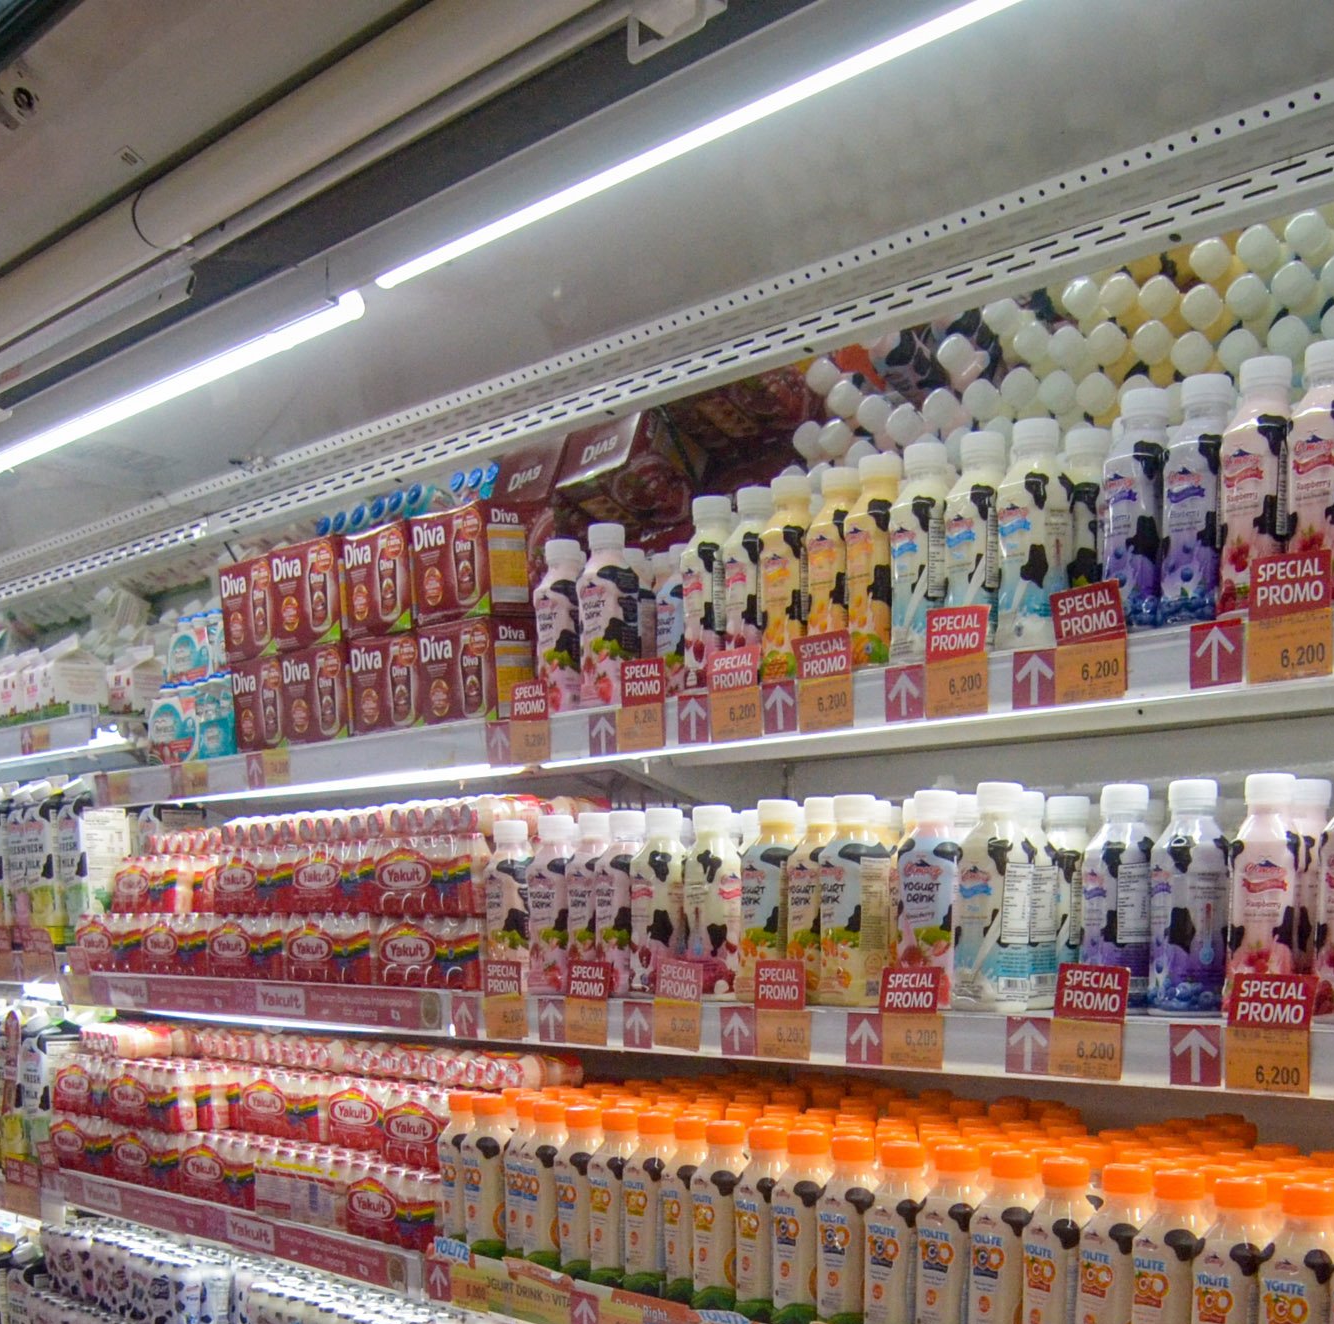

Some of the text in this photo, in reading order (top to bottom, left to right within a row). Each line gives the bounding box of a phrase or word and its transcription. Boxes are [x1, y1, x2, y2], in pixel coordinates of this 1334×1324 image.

[1257, 557, 1324, 584] SPECIAL
[1057, 589, 1114, 617] SPECIAL
[1257, 580, 1324, 608] PROMO
[931, 613, 980, 633] SPECIAL
[1060, 609, 1117, 638] PROMO
[930, 632, 979, 652] PROMO
[712, 652, 753, 672] SPECIAL
[1281, 643, 1326, 669] 6,200
[624, 664, 660, 680] SPECIAL
[712, 669, 753, 690] PROMO
[1081, 658, 1119, 682] 6,200
[625, 679, 661, 697] PROMO
[949, 673, 982, 695] 6,200
[387, 868, 423, 887] Yakult
[903, 882, 941, 893] YOGURT
[390, 940, 426, 961] Yakult
[759, 967, 798, 983] SPECIAL
[887, 973, 935, 988] SPECIAL
[1065, 969, 1121, 991] SPECIAL
[758, 984, 799, 1001] PROMO
[885, 991, 933, 1009] PROMO
[1240, 979, 1306, 1000] SPECIAL
[1063, 990, 1120, 1013] PROMO
[1236, 1001, 1305, 1024] PROMO
[1076, 1040, 1114, 1061] 6,200
[1255, 1065, 1301, 1086] 6,200
[338, 1103, 369, 1124] Yakult
[393, 1118, 428, 1138] Yakult
